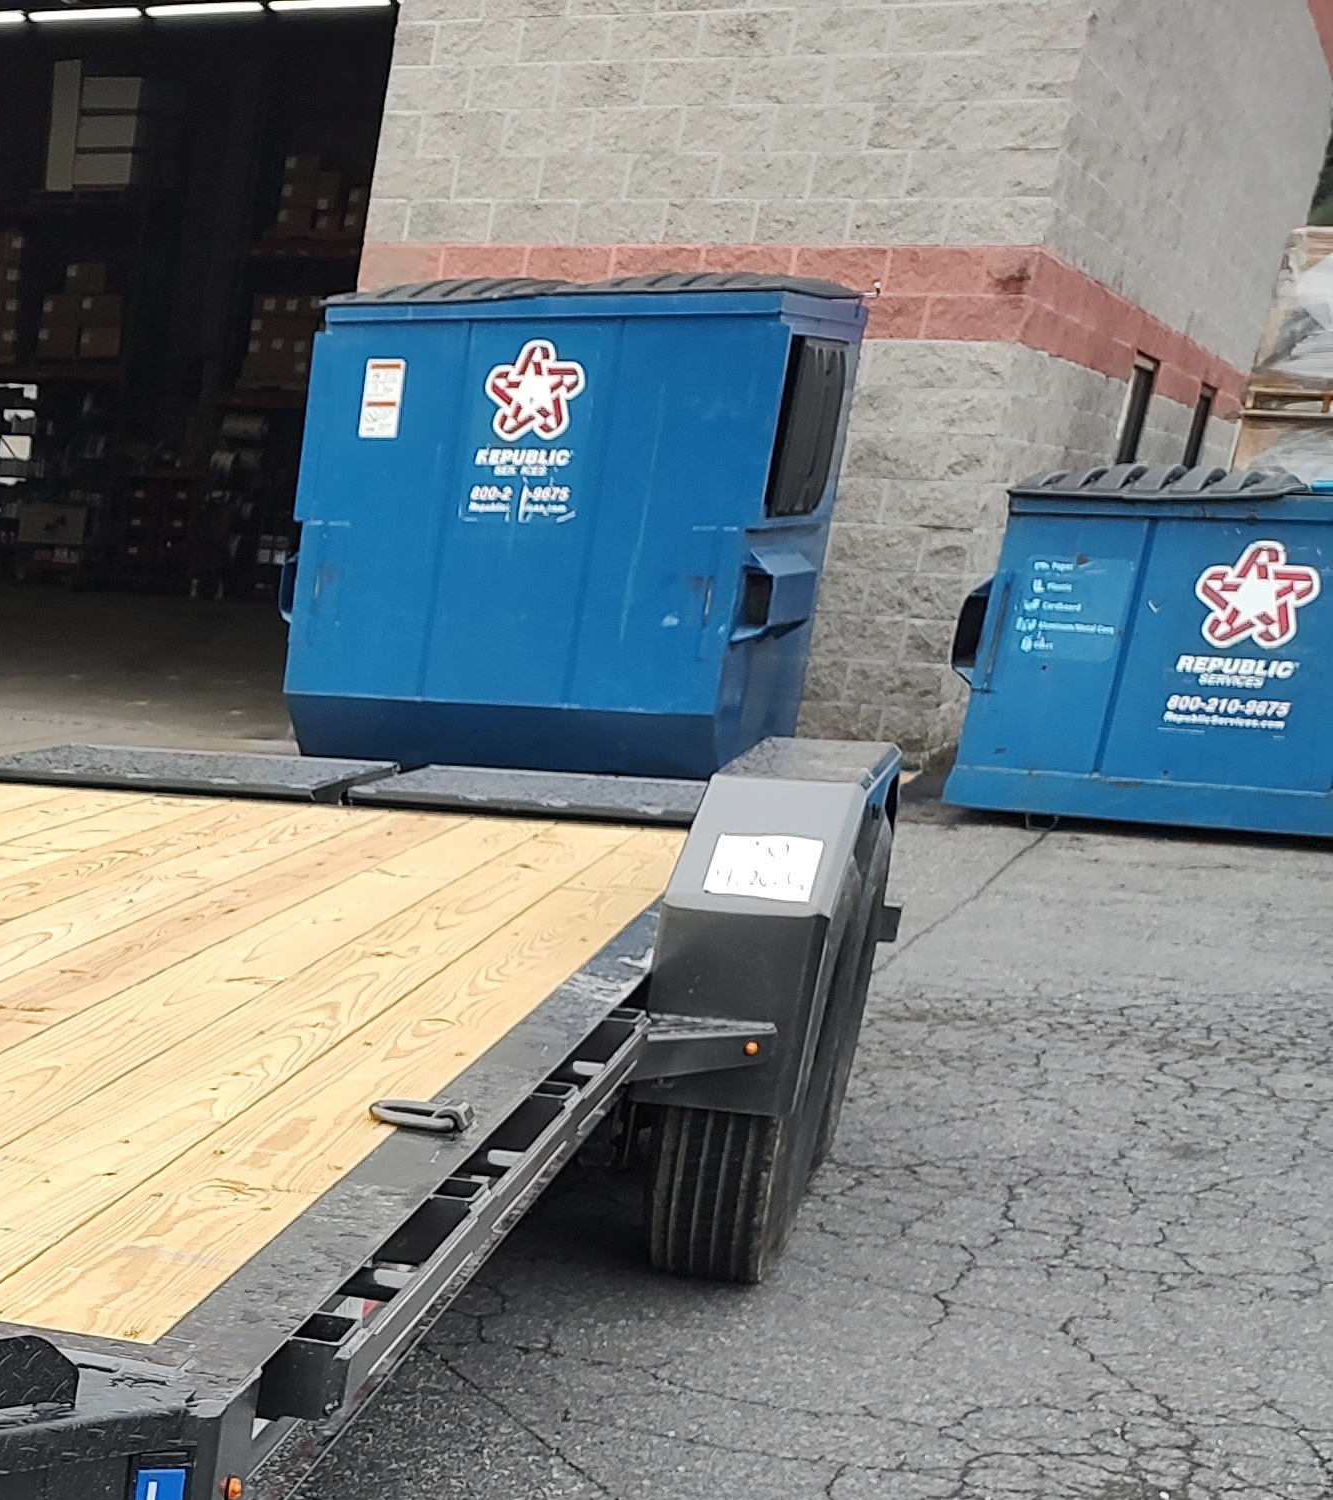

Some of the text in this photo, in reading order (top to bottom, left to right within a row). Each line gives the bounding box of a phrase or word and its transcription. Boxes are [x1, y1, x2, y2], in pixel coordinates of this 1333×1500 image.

[474, 448, 571, 467] REPUBLIC
[493, 465, 548, 476] SERICES
[1175, 654, 1294, 679] REPUBLIC
[1197, 673, 1265, 689] SERVICES
